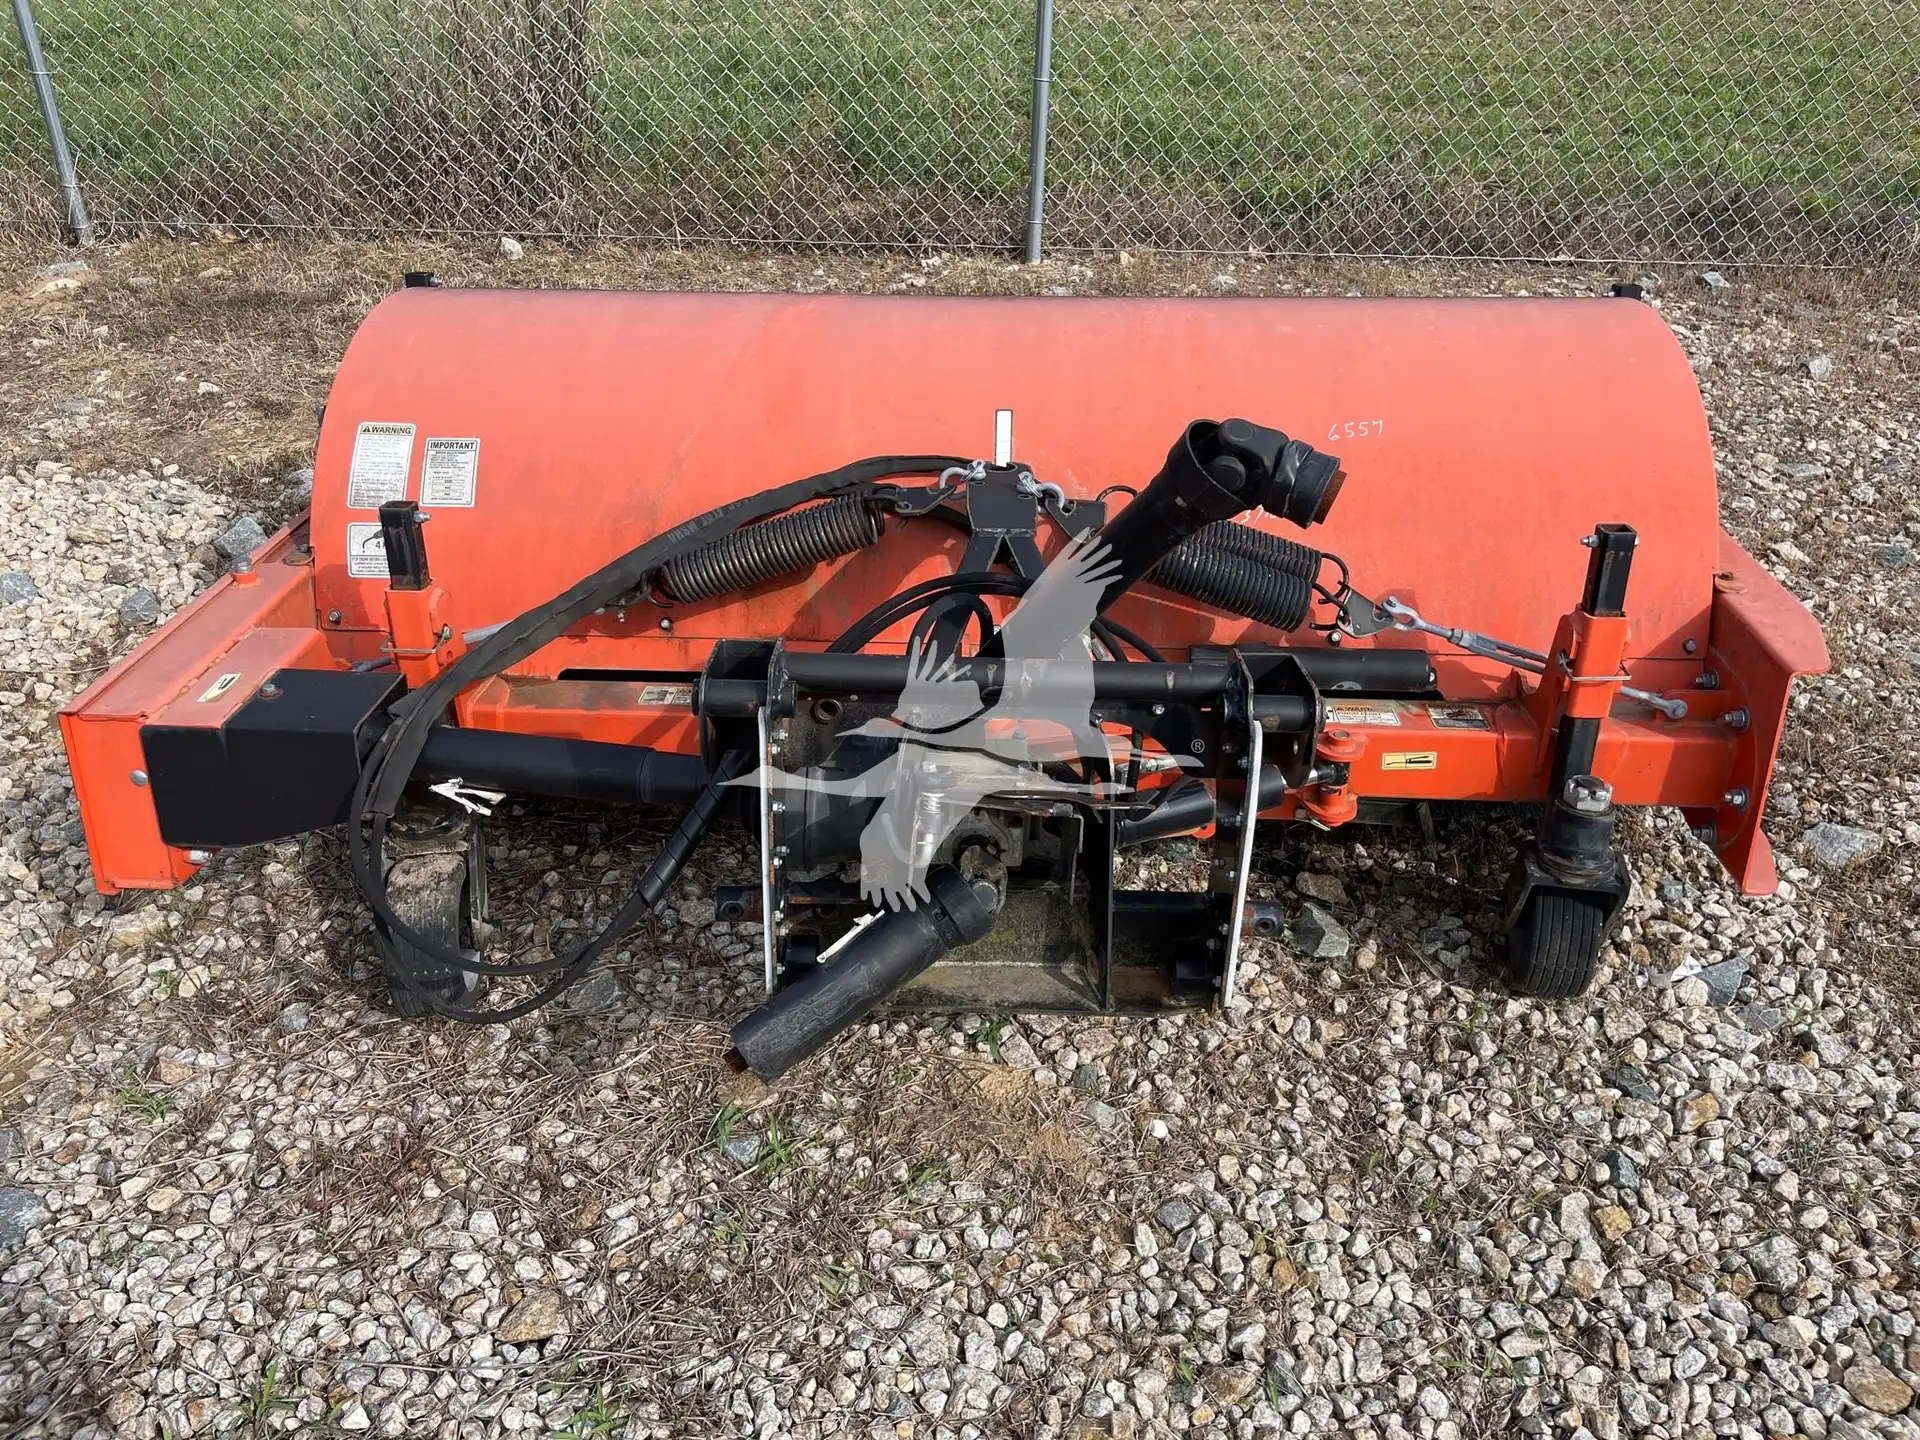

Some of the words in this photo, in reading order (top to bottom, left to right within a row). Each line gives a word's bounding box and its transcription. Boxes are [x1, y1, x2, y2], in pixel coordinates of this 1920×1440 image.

[372, 426, 411, 435] WARNING
[1328, 420, 1383, 441] 6557
[430, 441, 475, 450] IMPORTANT
